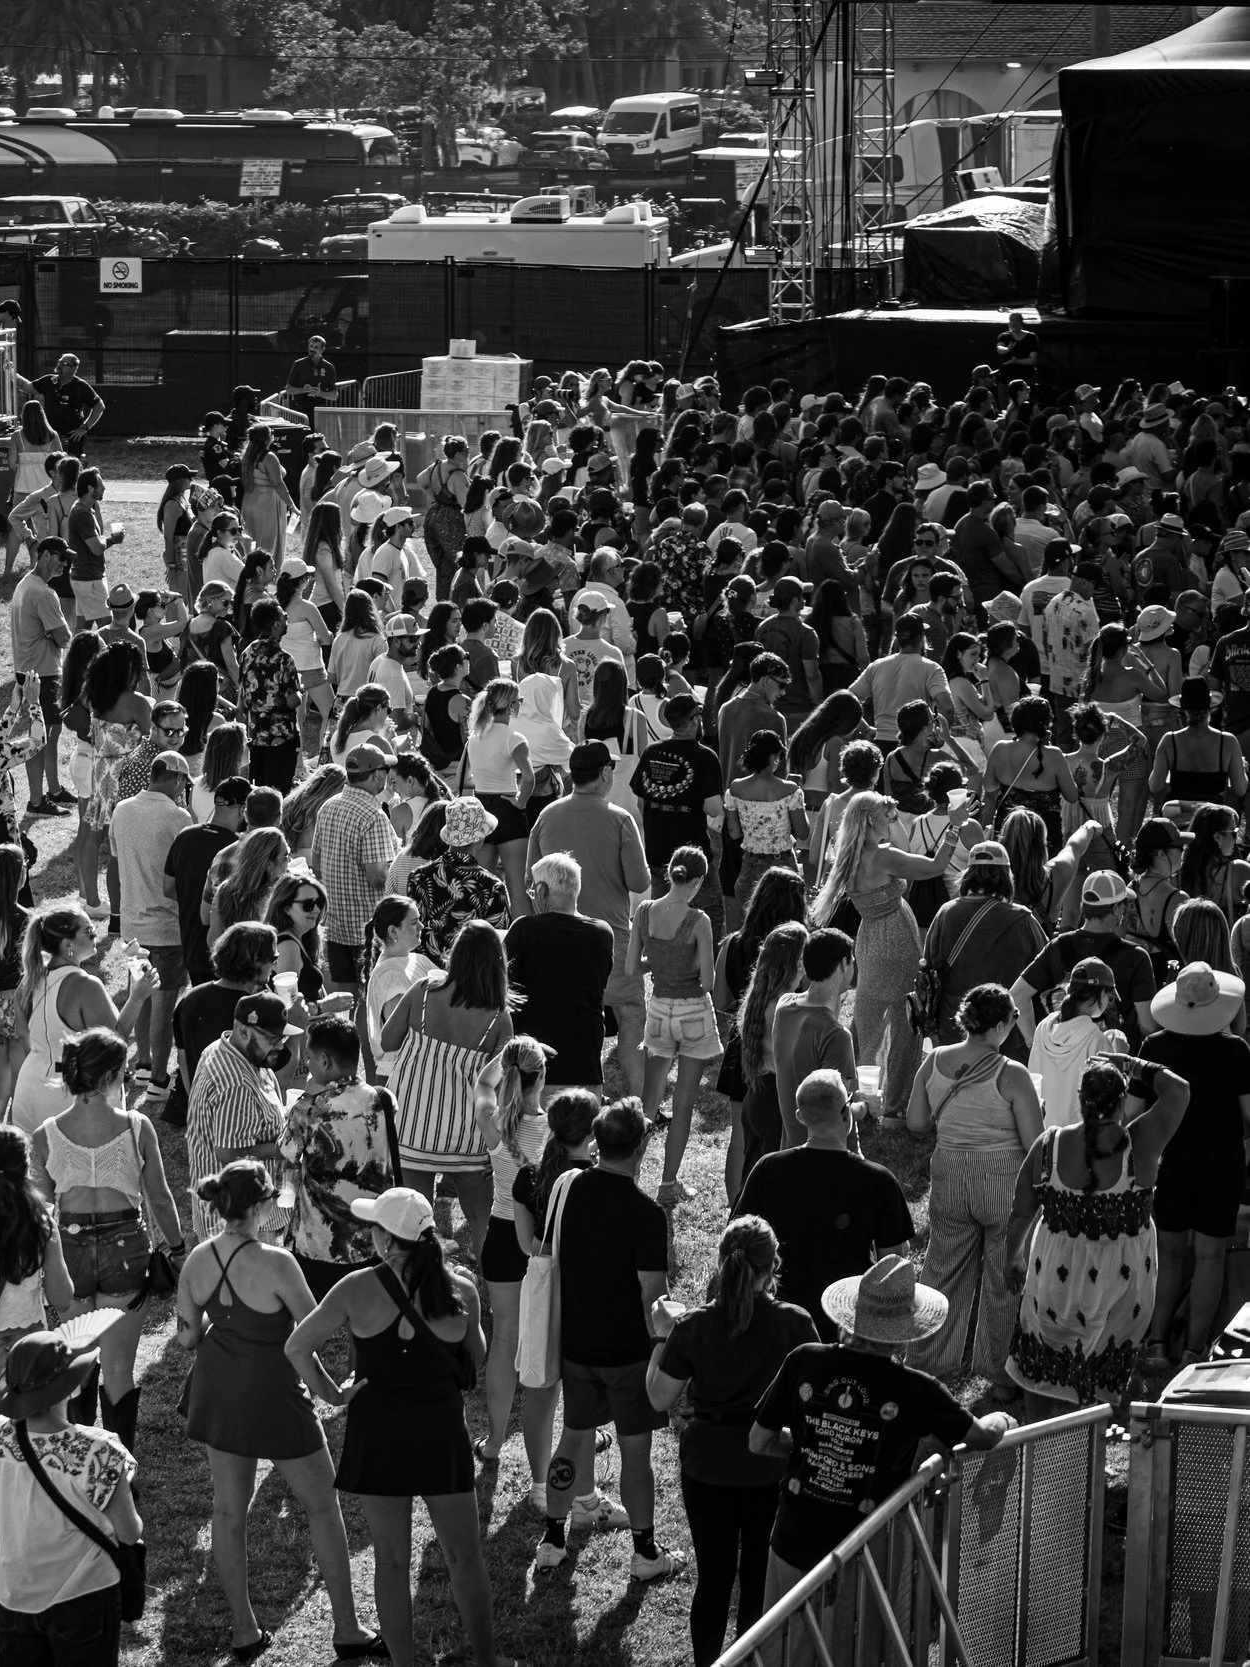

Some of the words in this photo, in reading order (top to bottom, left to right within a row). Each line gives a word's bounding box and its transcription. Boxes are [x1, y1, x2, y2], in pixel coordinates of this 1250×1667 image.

[103, 281, 113, 289] NO
[113, 281, 139, 289] SMOKING
[841, 1377, 858, 1386] OUT
[805, 1414, 821, 1426] THE
[821, 1419, 852, 1435] BLACK
[853, 1427, 880, 1440] KEYS
[815, 1426, 835, 1437] LORD
[835, 1432, 864, 1445] HURON
[818, 1440, 833, 1448] WAR
[800, 1446, 839, 1468] MUMFORD
[839, 1462, 846, 1470] &
[847, 1463, 876, 1474] SONS
[832, 1467, 864, 1479] ROGERS
